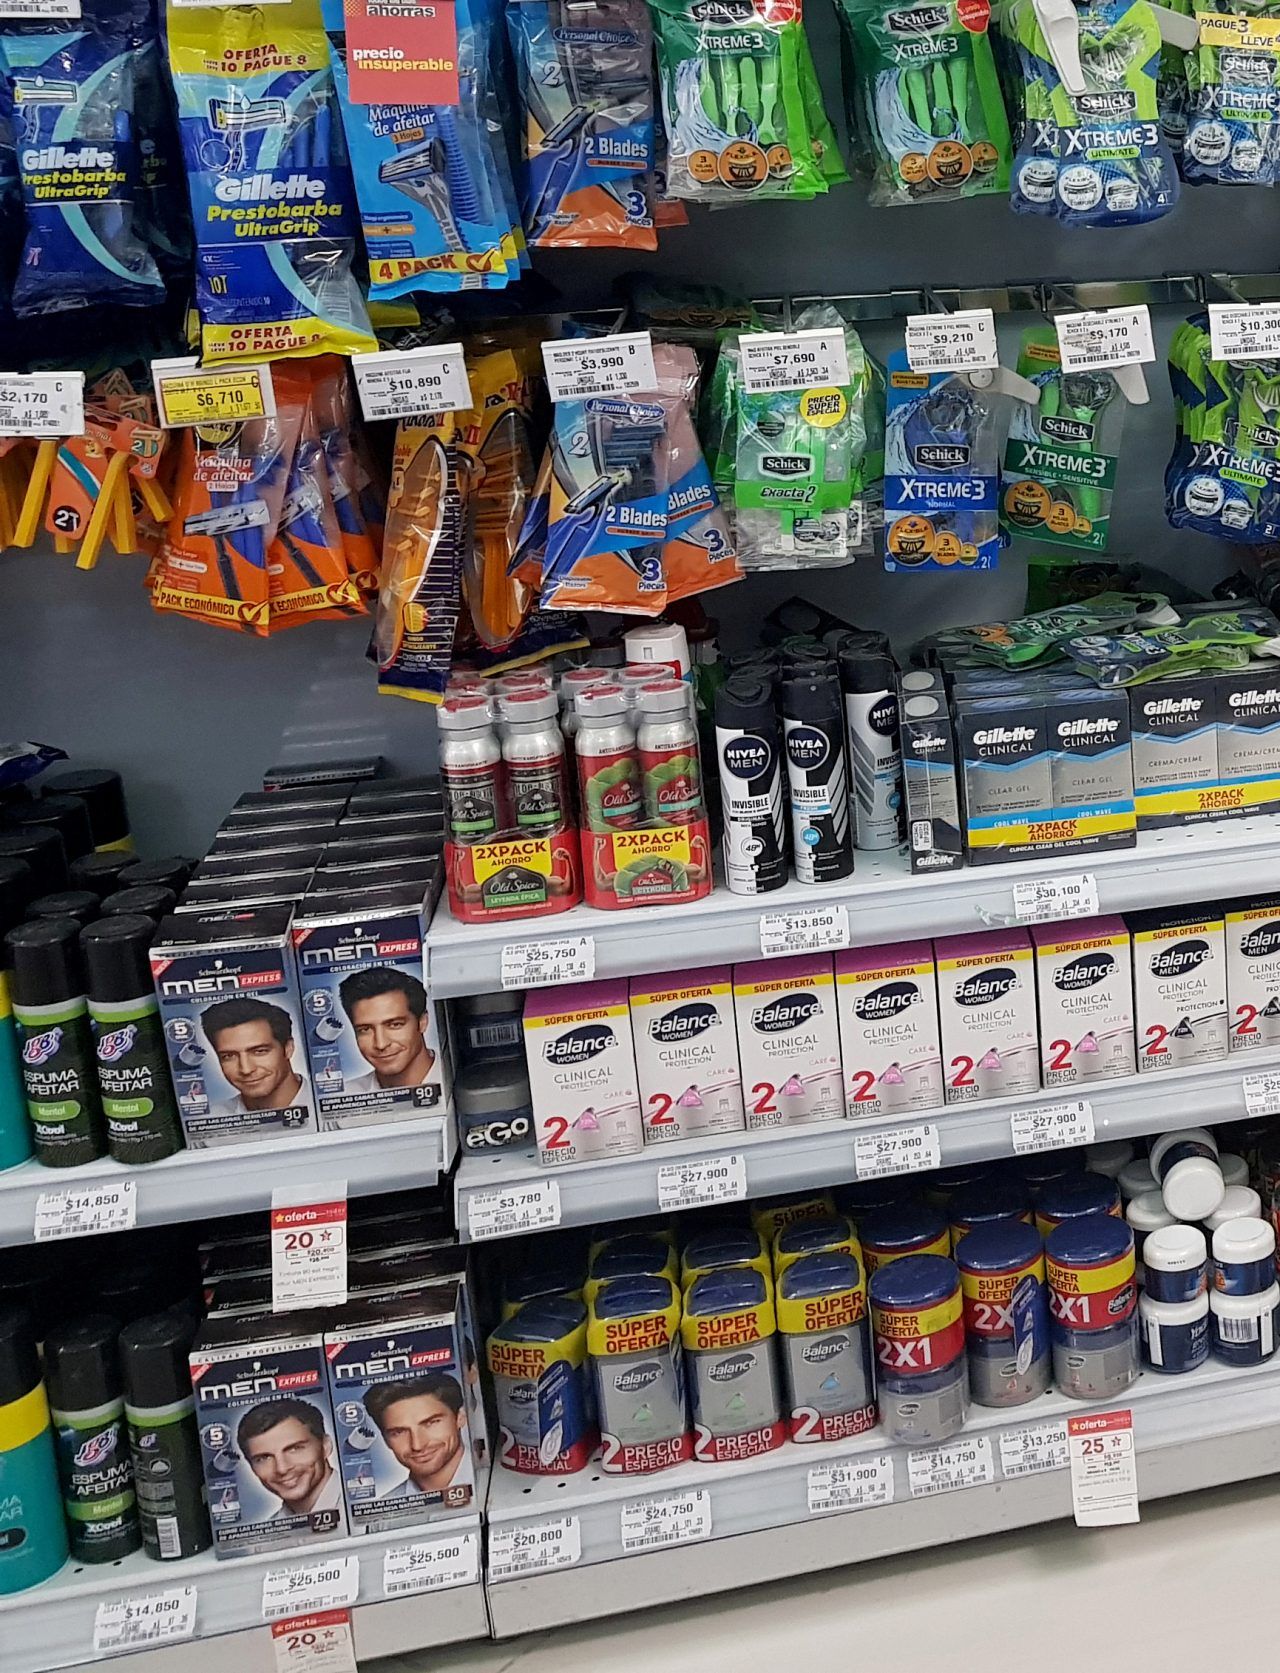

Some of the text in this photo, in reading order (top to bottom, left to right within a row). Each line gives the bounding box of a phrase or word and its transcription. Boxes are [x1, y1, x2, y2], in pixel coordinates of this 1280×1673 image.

[366, 4, 435, 18] ahorras
[1200, 18, 1248, 33] PAGUE 3
[1241, 34, 1273, 47] LLEVE
[224, 43, 278, 60] OFERTA
[353, 49, 404, 61] precio
[221, 54, 307, 73] 10 PAGUE 8
[358, 58, 454, 72] insuperable
[1080, 95, 1130, 108] Schick
[215, 175, 327, 200] Gillette
[207, 203, 342, 222] Prestobarba
[235, 219, 320, 237] UltraGrip
[379, 254, 457, 279] 4 PACK
[807, 394, 840, 404] PRECIO
[807, 407, 840, 415] ESPECIAL
[1044, 420, 1089, 438] Schick
[766, 457, 806, 471] Schick
[1222, 469, 1264, 485] ULTIMATE
[759, 486, 814, 503] Exacta 2
[606, 508, 667, 526] 2 Blades
[643, 560, 660, 581] 3
[638, 581, 665, 591] Pieces
[160, 593, 235, 617] PACK ECONÓMICO
[973, 726, 1037, 745] Gillette
[727, 748, 766, 760] NIVEA
[979, 742, 1033, 756] CLINICAL
[730, 757, 763, 768] MEN
[1148, 756, 1203, 767] CREMA/CREME
[988, 784, 1030, 795] CLEAR GEL
[476, 841, 547, 859] 2XPACK
[492, 855, 532, 865] AHORRO
[490, 880, 539, 895] Old Spice
[490, 893, 540, 904] LEYENDA ÉPICA
[241, 973, 281, 986] EXPRESS
[542, 1034, 614, 1055] Balance
[557, 1052, 589, 1062] WOMEN
[554, 1068, 613, 1083] CLINICAL
[39, 1106, 66, 1117] Mentol
[284, 1109, 301, 1121] 90
[543, 1117, 570, 1148] 2
[542, 1147, 575, 1158] PRECIO
[543, 1155, 576, 1164] ESPECIAL
[285, 1210, 317, 1220] oferta
[285, 1233, 312, 1249] 20
[606, 1316, 666, 1336] SÚPER
[606, 1333, 669, 1354] OFERTA
[879, 1339, 932, 1367] 2X1
[624, 1439, 682, 1460] PRECIO
[1081, 1439, 1104, 1454] 25
[625, 1452, 683, 1472] ESPECIAL
[314, 1513, 332, 1525] 70
